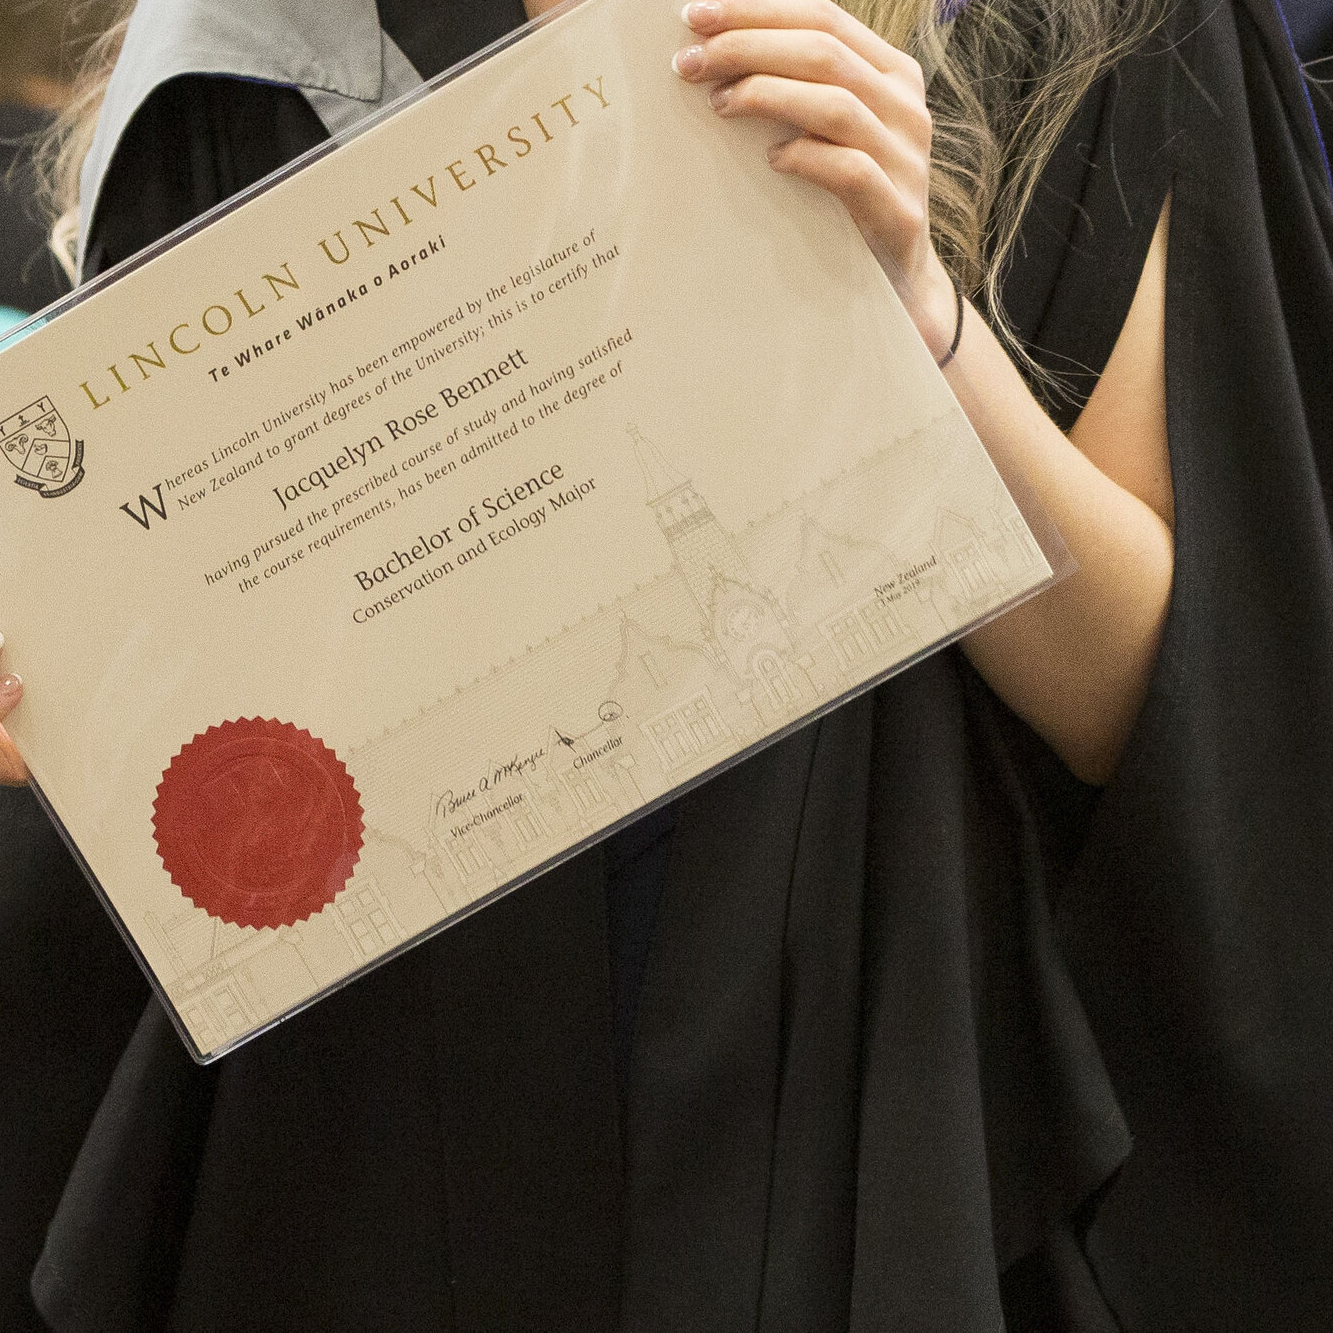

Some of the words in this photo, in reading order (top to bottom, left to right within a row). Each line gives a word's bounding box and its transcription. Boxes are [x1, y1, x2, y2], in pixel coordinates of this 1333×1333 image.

[78, 261, 301, 411] LINCOLN
[316, 75, 611, 266] UNIVERSITY
[207, 365, 231, 383] Te
[233, 328, 292, 368] Whare
[295, 283, 369, 332] Wānaka
[372, 275, 384, 288] o
[388, 234, 446, 280] Aoraki
[177, 487, 206, 511] New
[209, 451, 265, 493] Zealand
[265, 445, 281, 459] to
[283, 420, 320, 453] grant
[322, 391, 372, 427] degrees
[374, 376, 388, 396] of
[390, 367, 413, 386] the
[414, 325, 485, 371] University;
[487, 308, 514, 329] this
[514, 300, 528, 313] is
[530, 290, 545, 305] to
[547, 263, 588, 295] certify
[591, 244, 620, 269] that
[210, 429, 261, 465] Lincoln
[261, 389, 327, 434] University
[328, 374, 355, 395] has
[355, 354, 389, 379] been
[391, 306, 465, 359] empowered
[465, 298, 482, 314] by
[485, 284, 508, 303] the
[509, 242, 579, 289] legislature
[582, 228, 596, 247] of
[203, 553, 251, 586] having
[252, 518, 305, 562] pursued
[306, 507, 329, 527] the
[331, 464, 399, 516] prescribed
[401, 441, 443, 472] course
[445, 427, 459, 446] of
[462, 409, 497, 436] study
[501, 388, 528, 414] and
[528, 365, 576, 397] having
[577, 327, 634, 370] satisfied
[237, 575, 261, 594] the
[263, 549, 305, 580] course
[307, 498, 396, 554] requirements,
[397, 480, 423, 501] has
[423, 460, 457, 485] been
[460, 421, 519, 465] admitted
[521, 415, 536, 429] to
[537, 400, 561, 420] the
[563, 373, 607, 405] degree
[609, 359, 623, 378] of
[272, 435, 386, 512] Jacquelyn
[383, 403, 440, 442] Rose
[438, 348, 529, 409] Bennett
[352, 561, 455, 624] Conservation
[456, 537, 489, 566] and
[487, 506, 547, 547] Ecology
[547, 477, 597, 512] Major
[353, 526, 454, 592] Bachelor
[457, 504, 482, 534] of
[481, 464, 565, 519] Science
[873, 580, 896, 599] New
[897, 554, 937, 585] Zealand
[450, 793, 524, 838] Vice-Chancellor
[572, 736, 624, 770] Chancellor
